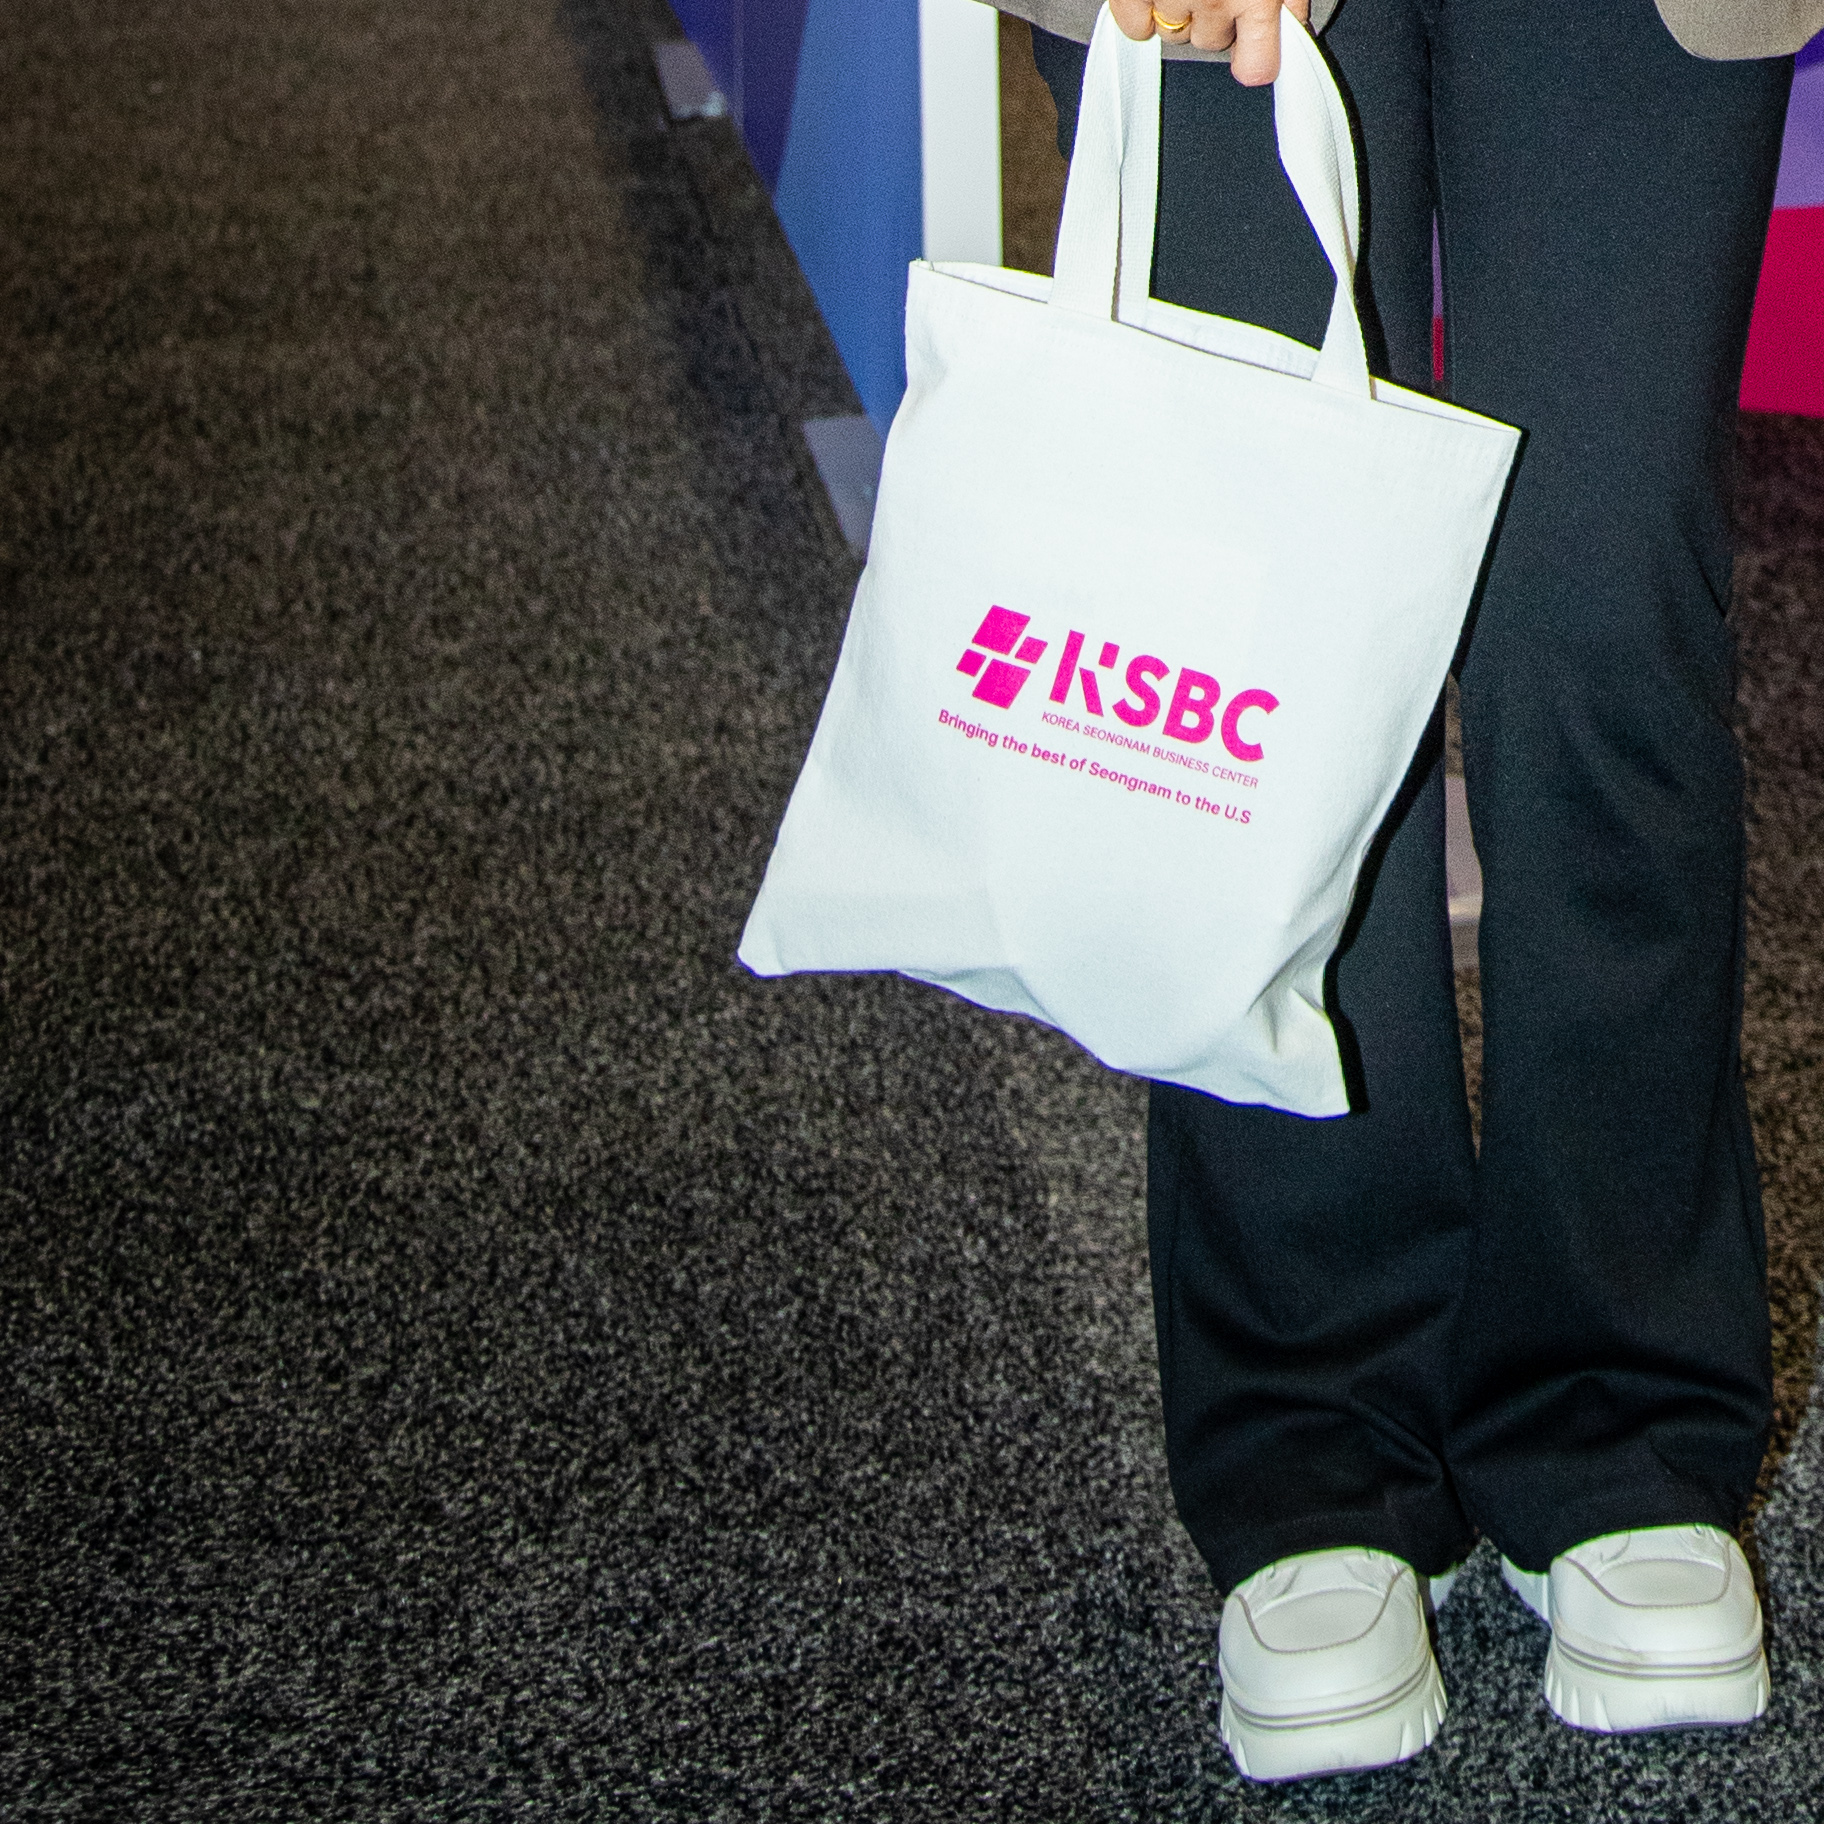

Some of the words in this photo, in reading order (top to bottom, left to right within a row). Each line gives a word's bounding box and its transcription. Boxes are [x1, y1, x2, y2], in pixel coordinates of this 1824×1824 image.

[938, 708, 999, 748] Bringing
[1002, 734, 1028, 754] the
[1031, 743, 1067, 767] best
[1069, 757, 1087, 772] of
[1088, 760, 1172, 800] Seongnam
[1175, 789, 1191, 806] to
[1194, 795, 1221, 816] the
[1223, 804, 1252, 825] U.S
[1041, 711, 1080, 733] KOREA
[1082, 724, 1151, 755] SEONGNAM
[1152, 746, 1210, 774] BUSINESS
[1212, 765, 1259, 789] CENTER
